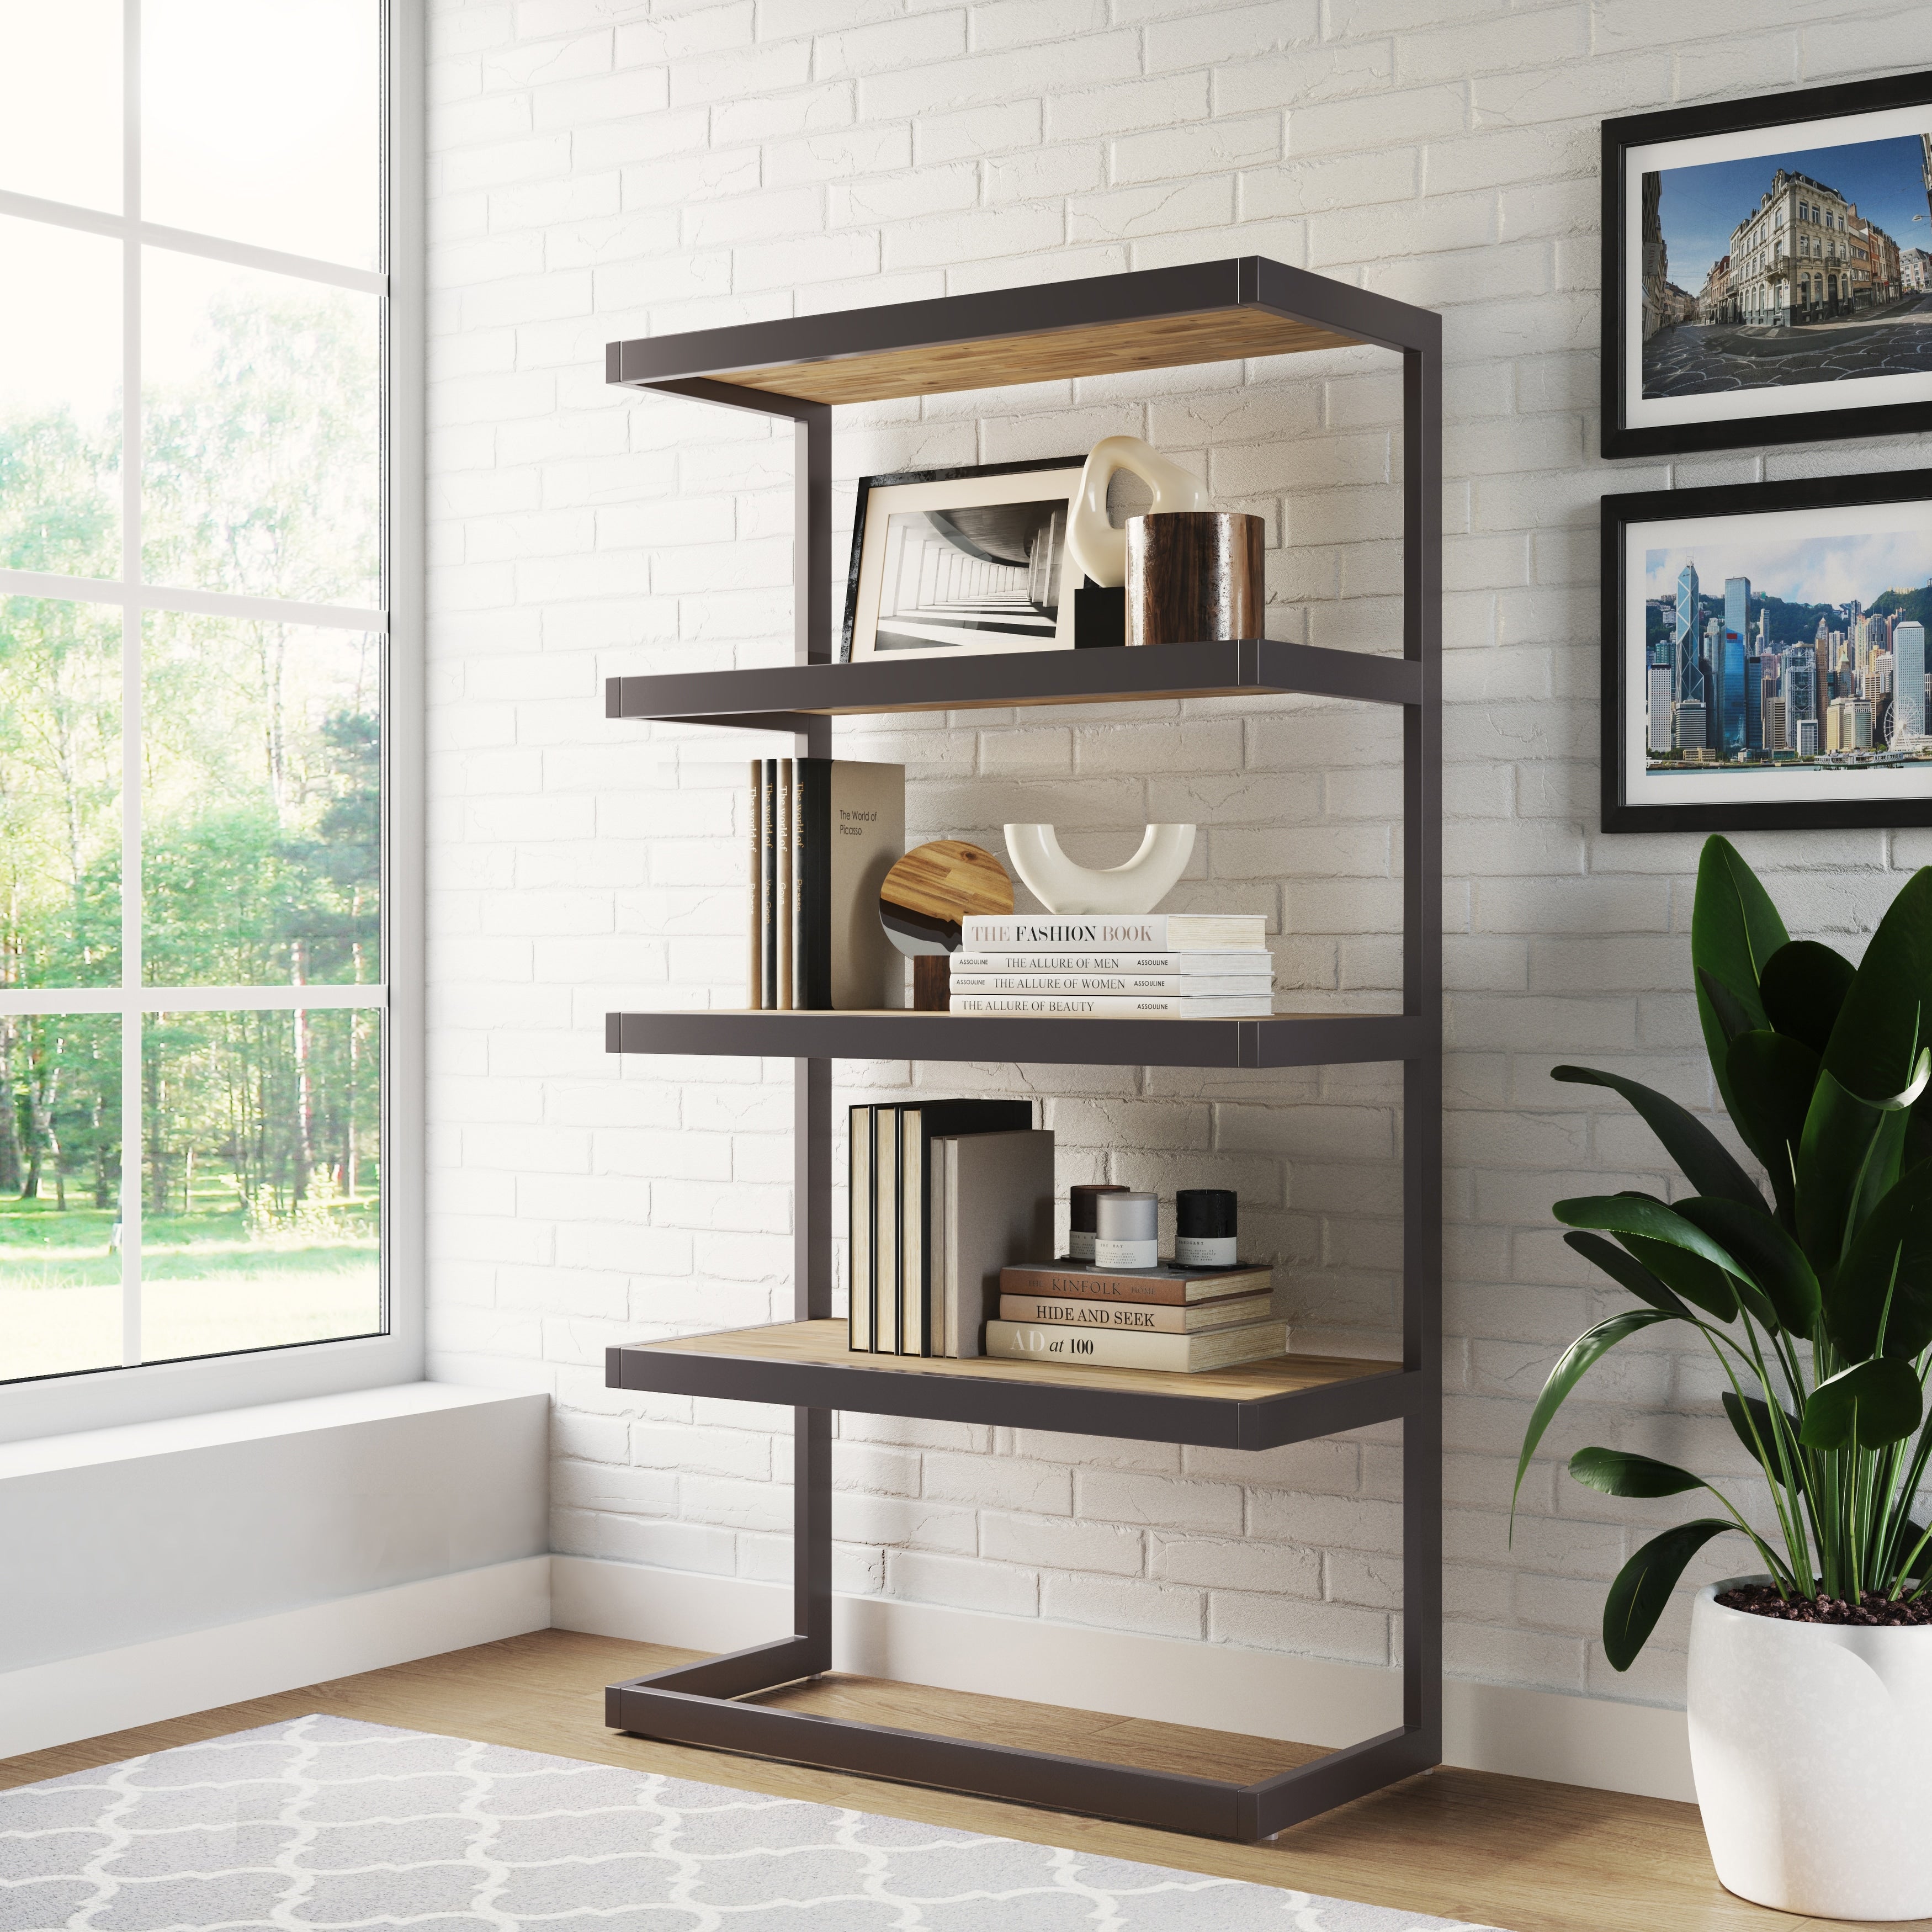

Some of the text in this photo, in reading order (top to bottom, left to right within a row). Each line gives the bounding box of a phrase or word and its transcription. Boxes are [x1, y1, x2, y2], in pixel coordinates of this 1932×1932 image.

[840, 810, 877, 821] The World of
[840, 825, 862, 835] Picasso
[750, 841, 757, 852] of
[766, 837, 773, 848] of
[780, 840, 787, 852] of
[796, 836, 804, 848] of
[972, 926, 1153, 942] THE FASHION BOOK
[1005, 958, 1119, 968] THE ALLURE OF MEN
[994, 978, 1126, 989] THE ALLURE OF WOMEN
[962, 1000, 1094, 1011] THE ALLURE OF BEAUTY
[1052, 1279, 1122, 1295] KINFOLK
[1036, 1305, 1155, 1327] HIDE AND SEEK
[1010, 1329, 1094, 1355] AD at 100
